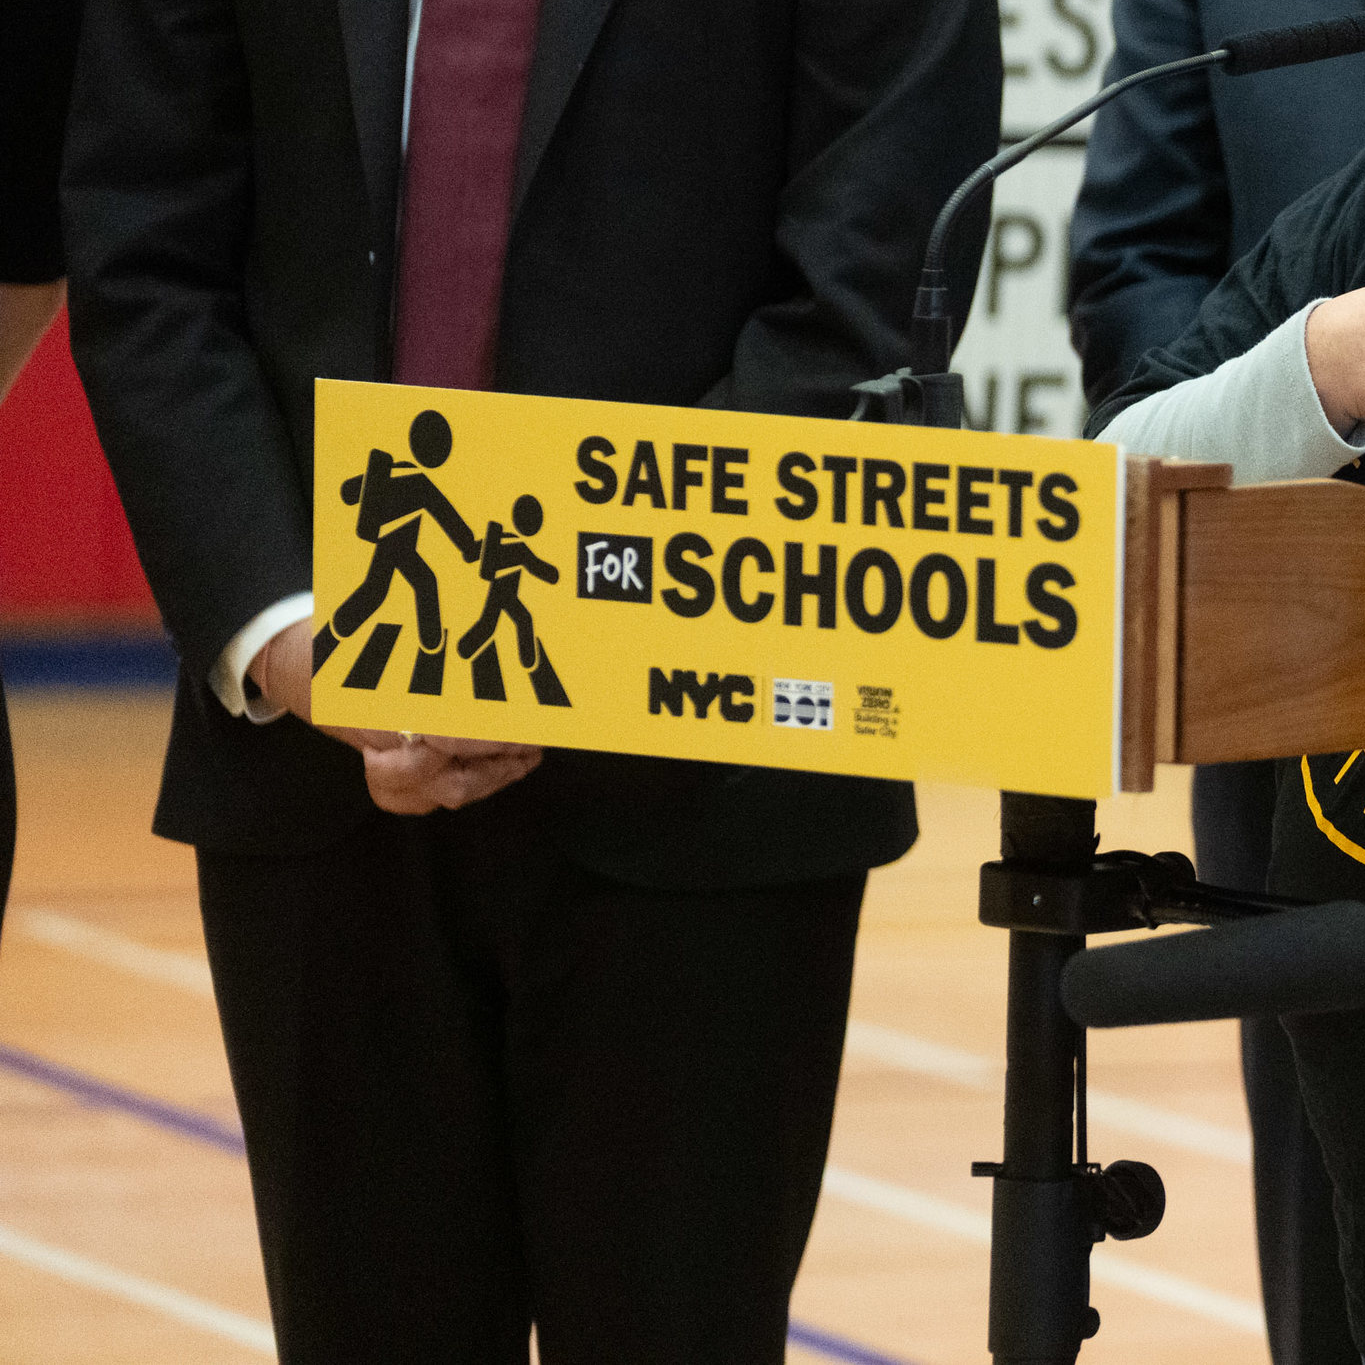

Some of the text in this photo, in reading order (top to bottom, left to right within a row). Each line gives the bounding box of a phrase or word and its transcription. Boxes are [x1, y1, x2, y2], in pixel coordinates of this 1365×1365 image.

[574, 435, 1082, 543] SAFE STREETS
[584, 530, 1080, 651] FOR SCHOOLS
[647, 666, 755, 724] NYC
